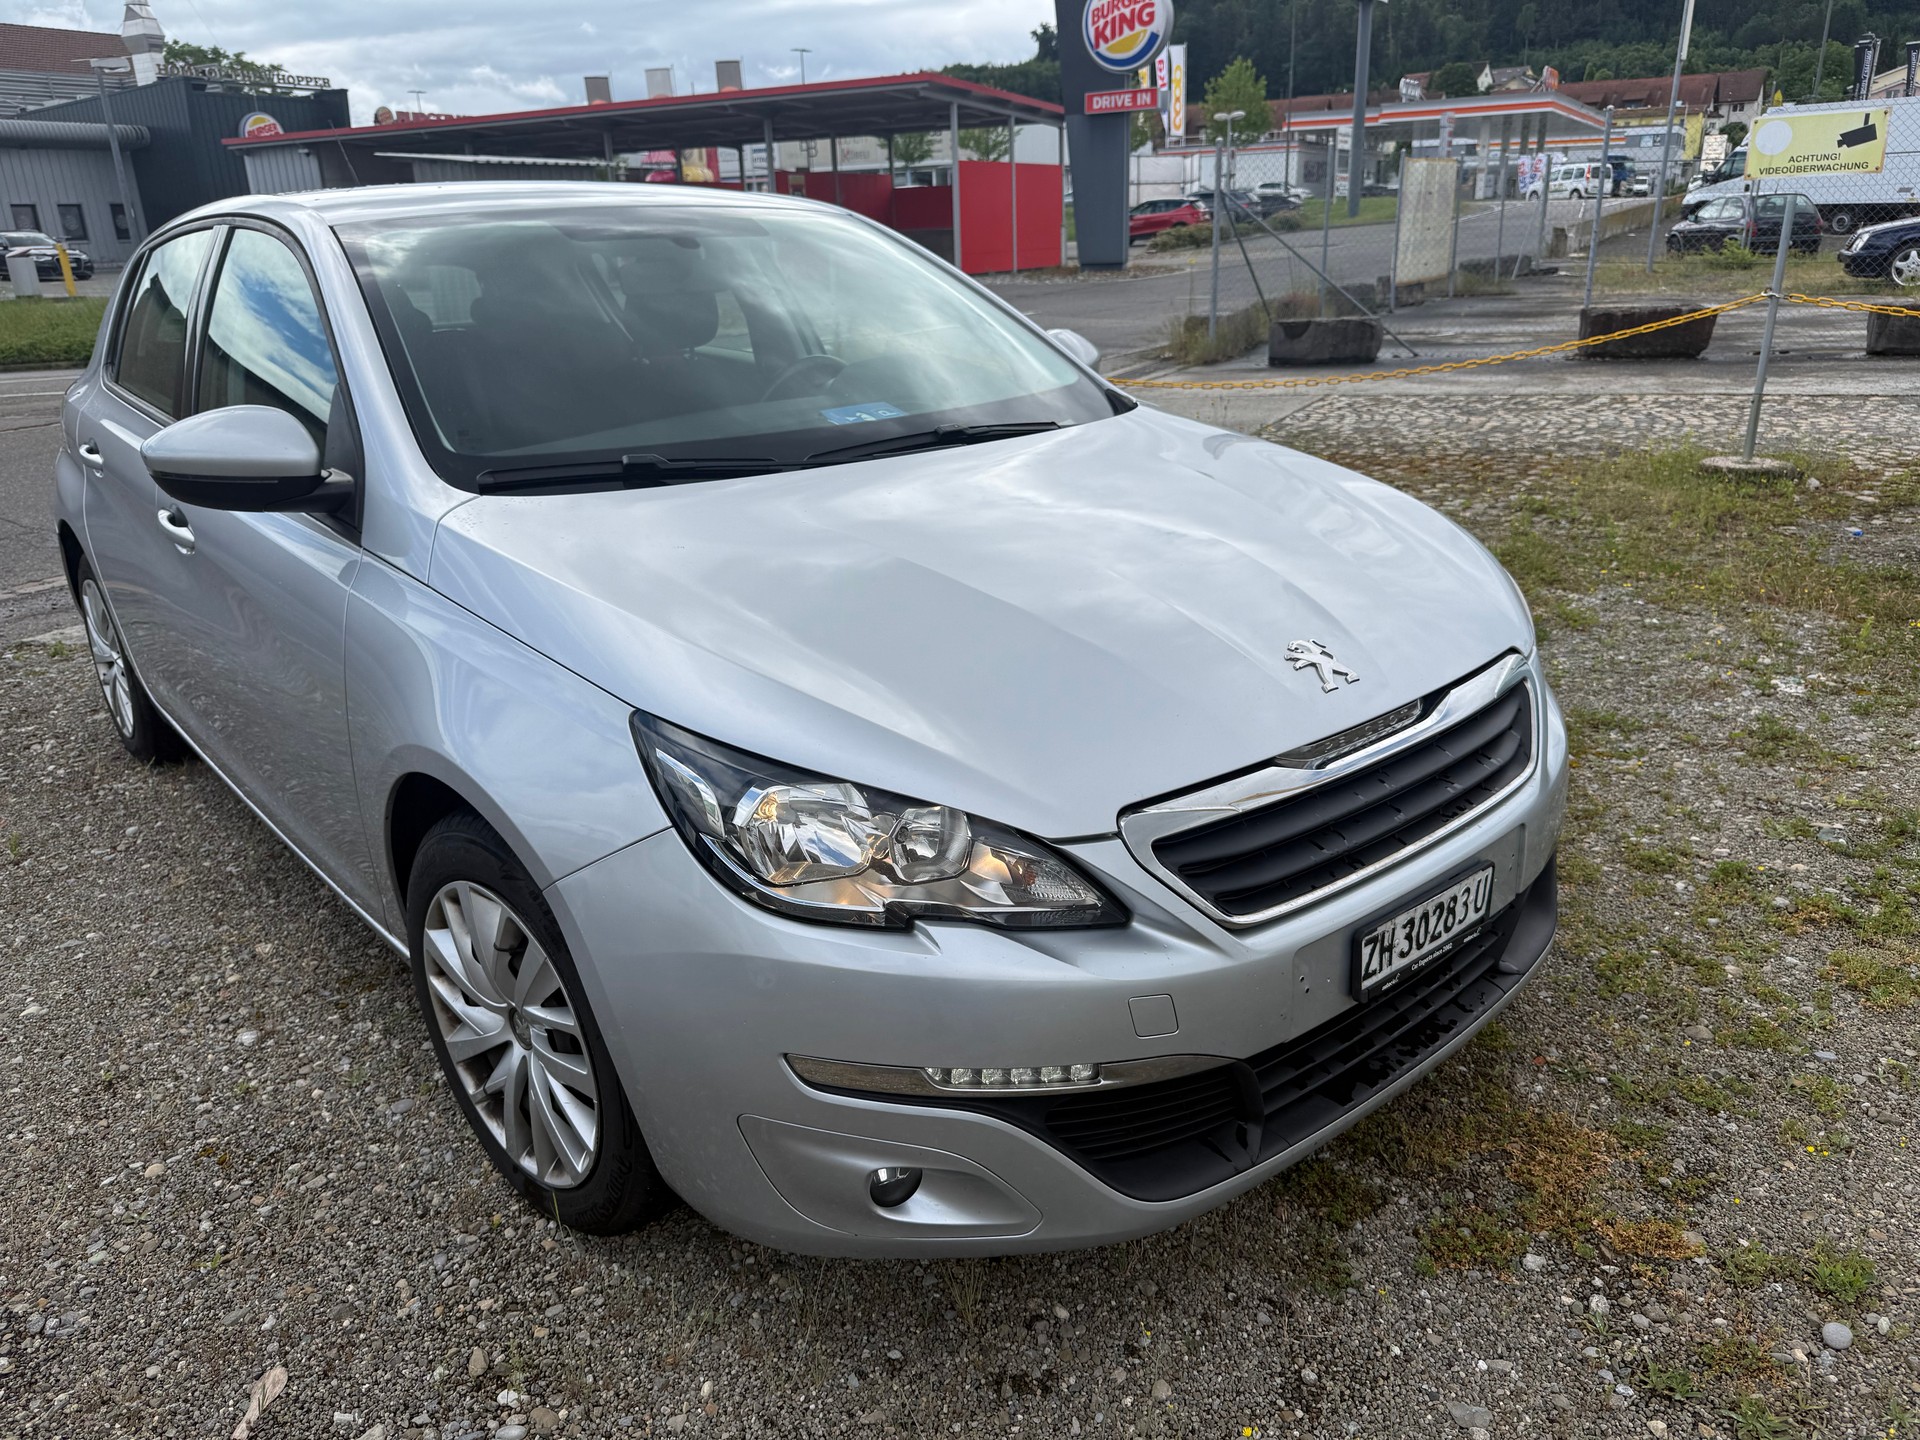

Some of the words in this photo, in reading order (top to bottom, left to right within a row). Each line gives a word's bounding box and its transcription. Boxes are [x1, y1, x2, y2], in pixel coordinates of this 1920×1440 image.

[1091, 0, 1147, 26] BURG
[1094, 2, 1155, 49] KING
[264, 69, 331, 88] WHOPPER
[1092, 93, 1132, 110] DRIVE
[1136, 92, 1151, 106] IN
[247, 123, 278, 137] BURGER
[1788, 152, 1841, 163] ACHTUNG!
[1759, 161, 1869, 175] VIDEOÜBERWACHUNG
[1399, 886, 1471, 958] 30283
